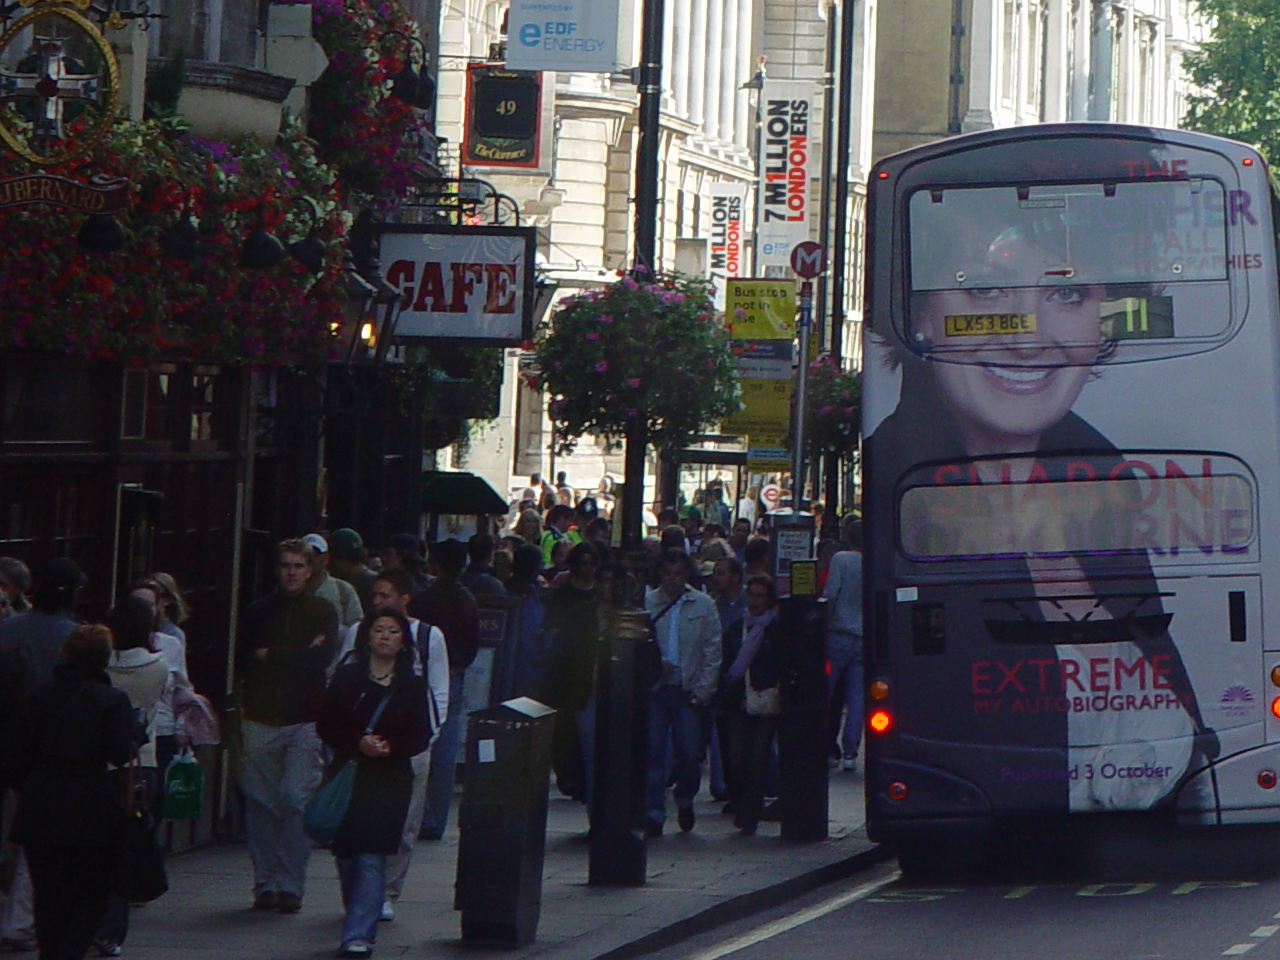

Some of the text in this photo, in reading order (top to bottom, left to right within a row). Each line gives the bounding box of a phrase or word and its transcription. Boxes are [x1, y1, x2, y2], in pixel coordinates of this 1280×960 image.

[544, 22, 578, 35] EDF
[543, 37, 605, 52] ENERGY
[495, 100, 517, 116] 49
[786, 99, 809, 222] LONDONERS
[1120, 159, 1188, 178] THE
[764, 209, 786, 222] 7
[726, 196, 741, 277] ONDONERS
[796, 247, 821, 277] M
[734, 287, 787, 300] Bus stop
[734, 300, 770, 311] not in
[734, 314, 755, 324] se
[954, 313, 1030, 332] LX53 BGE
[934, 458, 1213, 514] SHARON
[972, 654, 1174, 695] EXTREME
[973, 693, 1193, 714] MY AUTOBIOGRAPHY
[1084, 764, 1095, 781] 3
[1101, 762, 1174, 780] October
